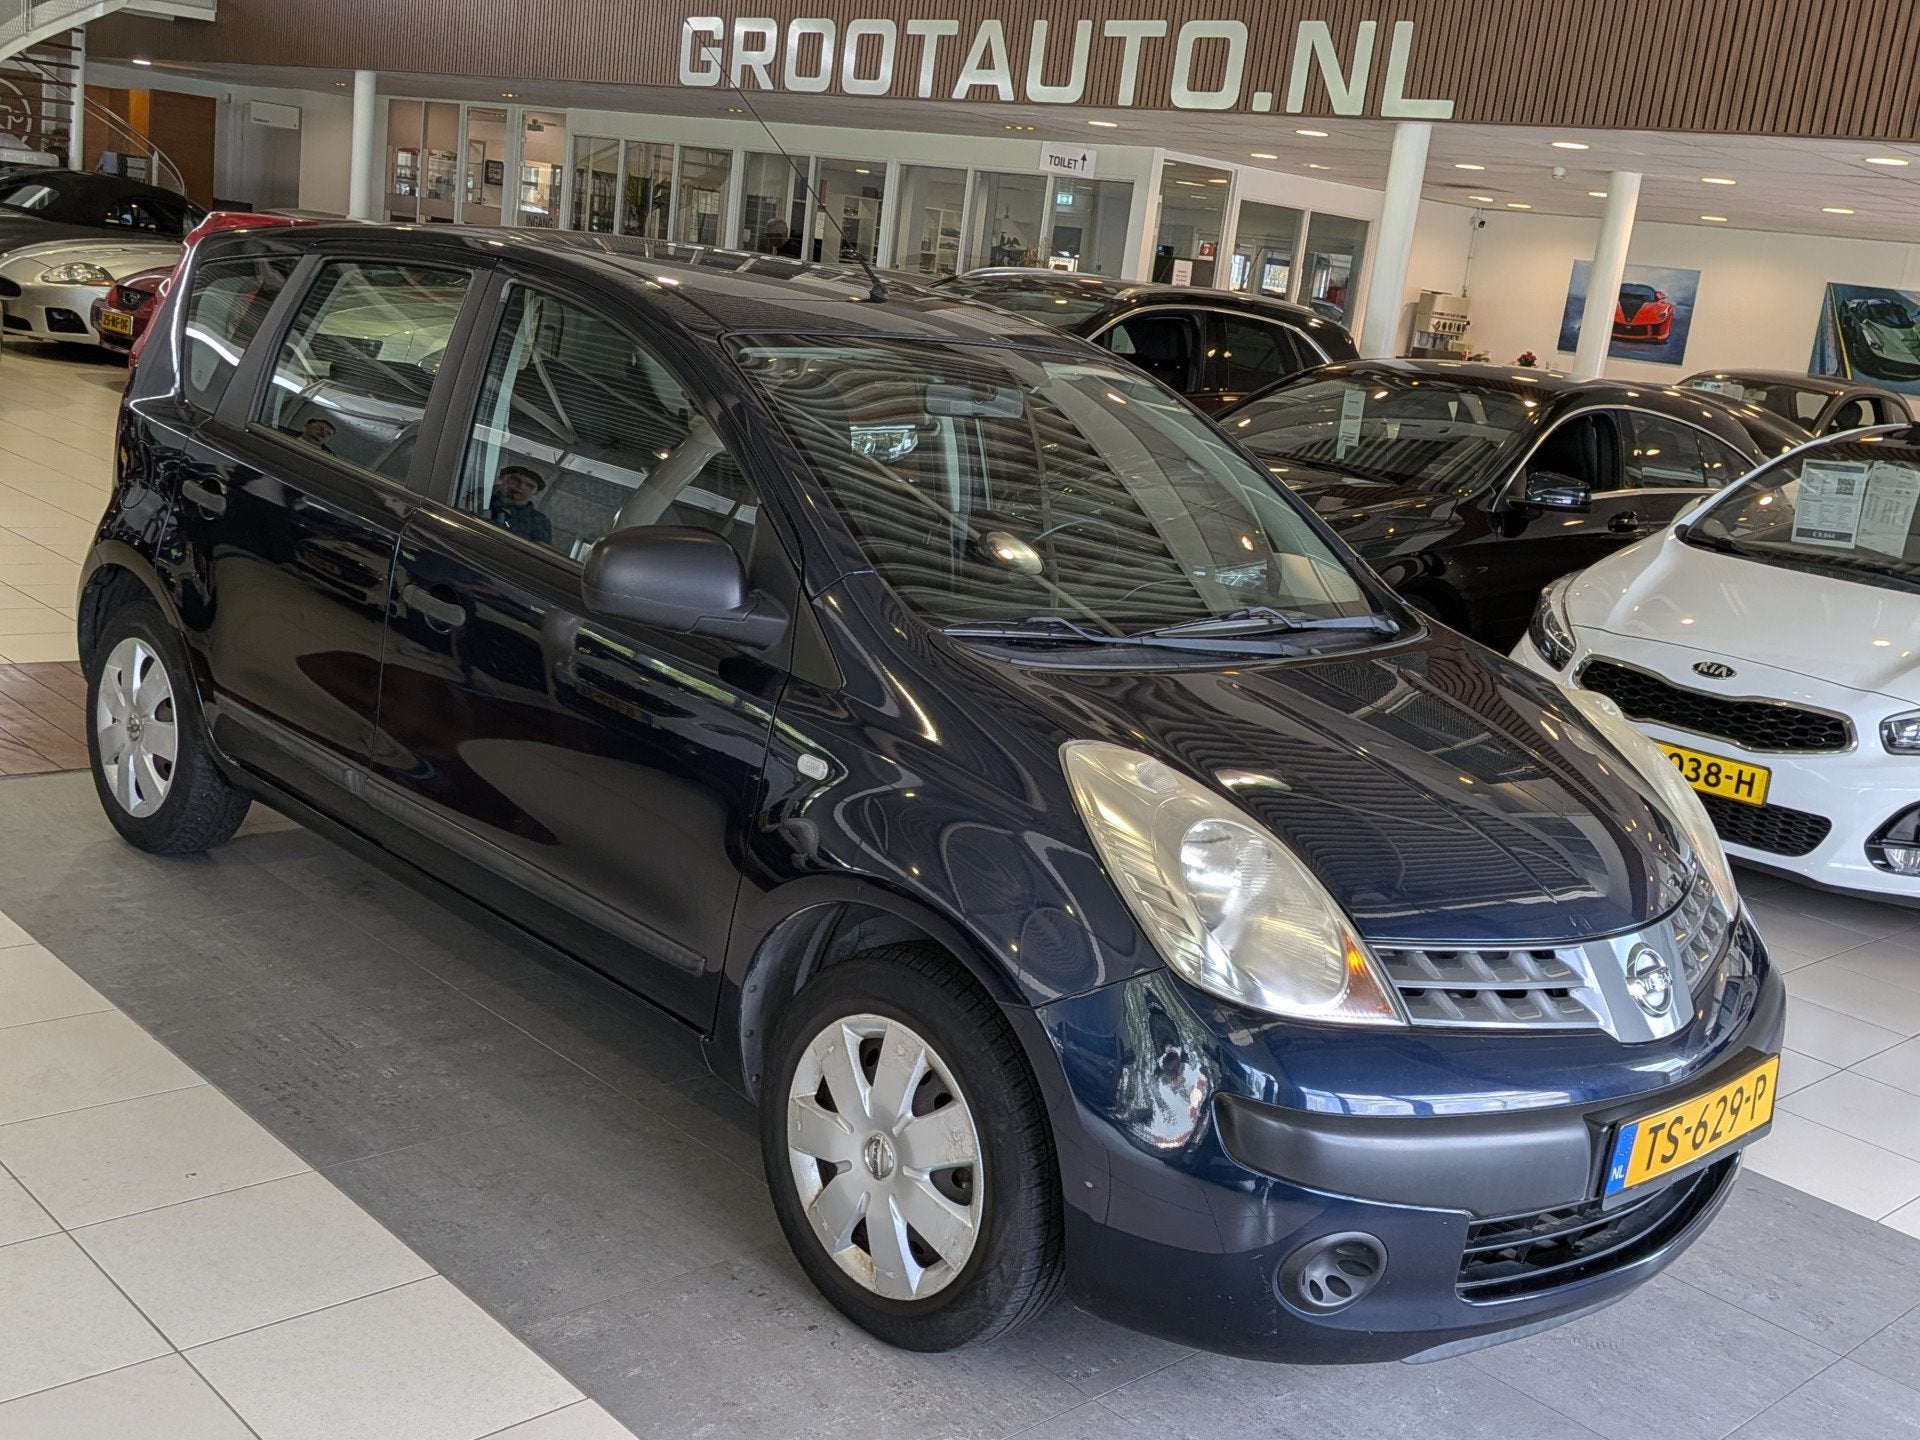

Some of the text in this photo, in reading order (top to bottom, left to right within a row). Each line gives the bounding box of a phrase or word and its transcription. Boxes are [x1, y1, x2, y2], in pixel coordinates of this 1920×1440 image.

[679, 16, 1454, 119] GROOTAUTO.NL
[1049, 155, 1078, 170] TOILET
[1697, 662, 1728, 677] KIA
[1645, 1074, 1767, 1171] TS-629-P
[1610, 1165, 1624, 1181] NL
